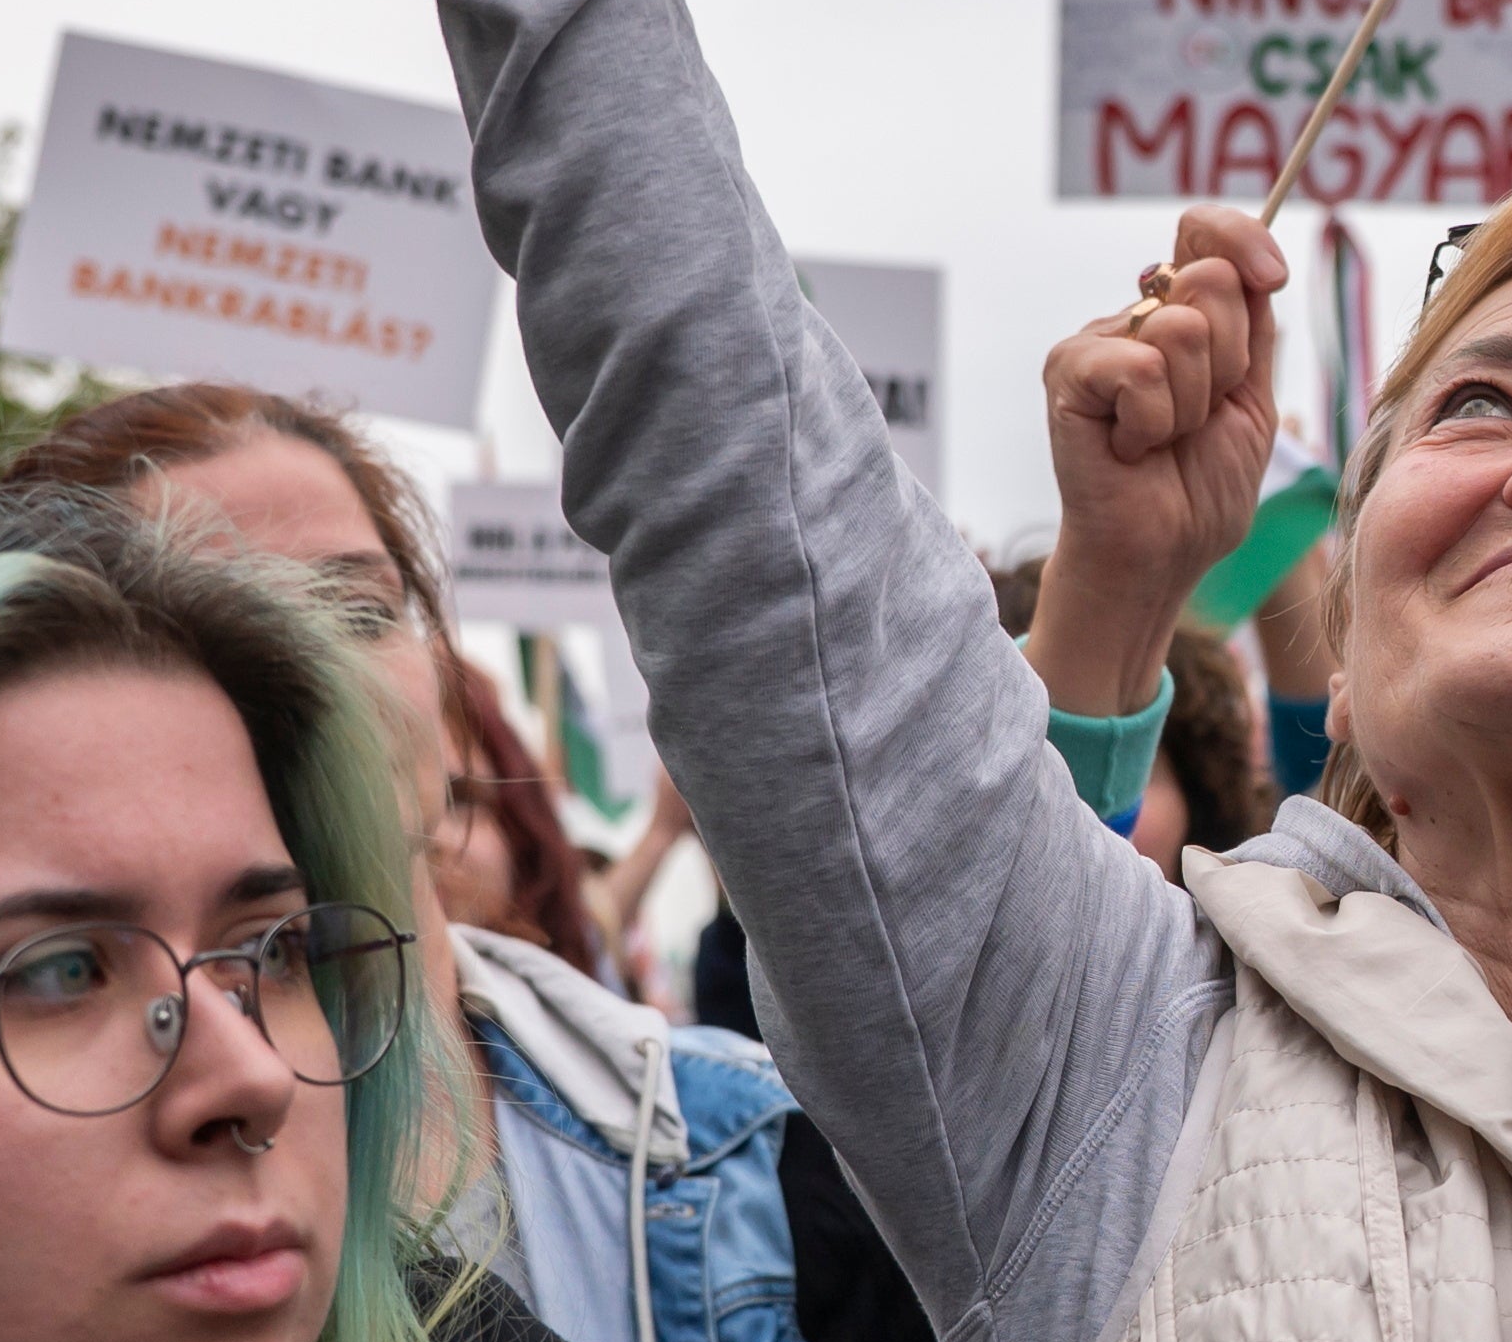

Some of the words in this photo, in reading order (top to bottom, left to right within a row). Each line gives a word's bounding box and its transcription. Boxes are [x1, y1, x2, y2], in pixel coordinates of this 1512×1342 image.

[1248, 33, 1439, 100] CSAK
[97, 102, 309, 177] NEMZETI
[322, 147, 463, 211] BANK
[204, 177, 343, 237] VAGY
[156, 220, 370, 295] NEMZETI
[68, 259, 435, 362] BANKRABLÁS?
